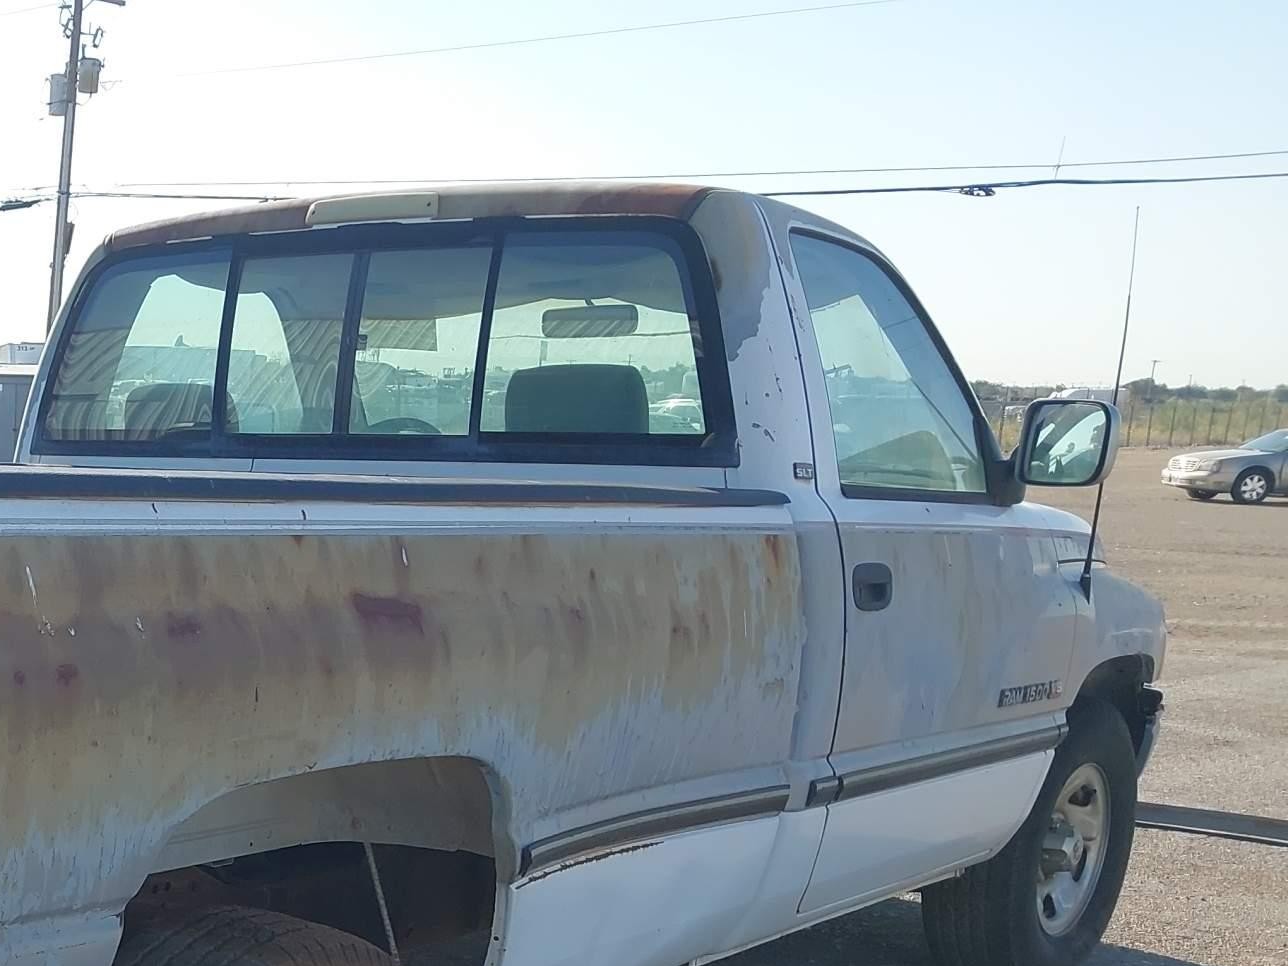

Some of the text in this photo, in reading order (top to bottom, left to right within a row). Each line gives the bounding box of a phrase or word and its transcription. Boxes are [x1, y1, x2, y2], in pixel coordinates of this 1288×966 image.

[796, 468, 813, 477] SLT
[998, 686, 1024, 706] RAM
[1024, 682, 1049, 703] 1500
